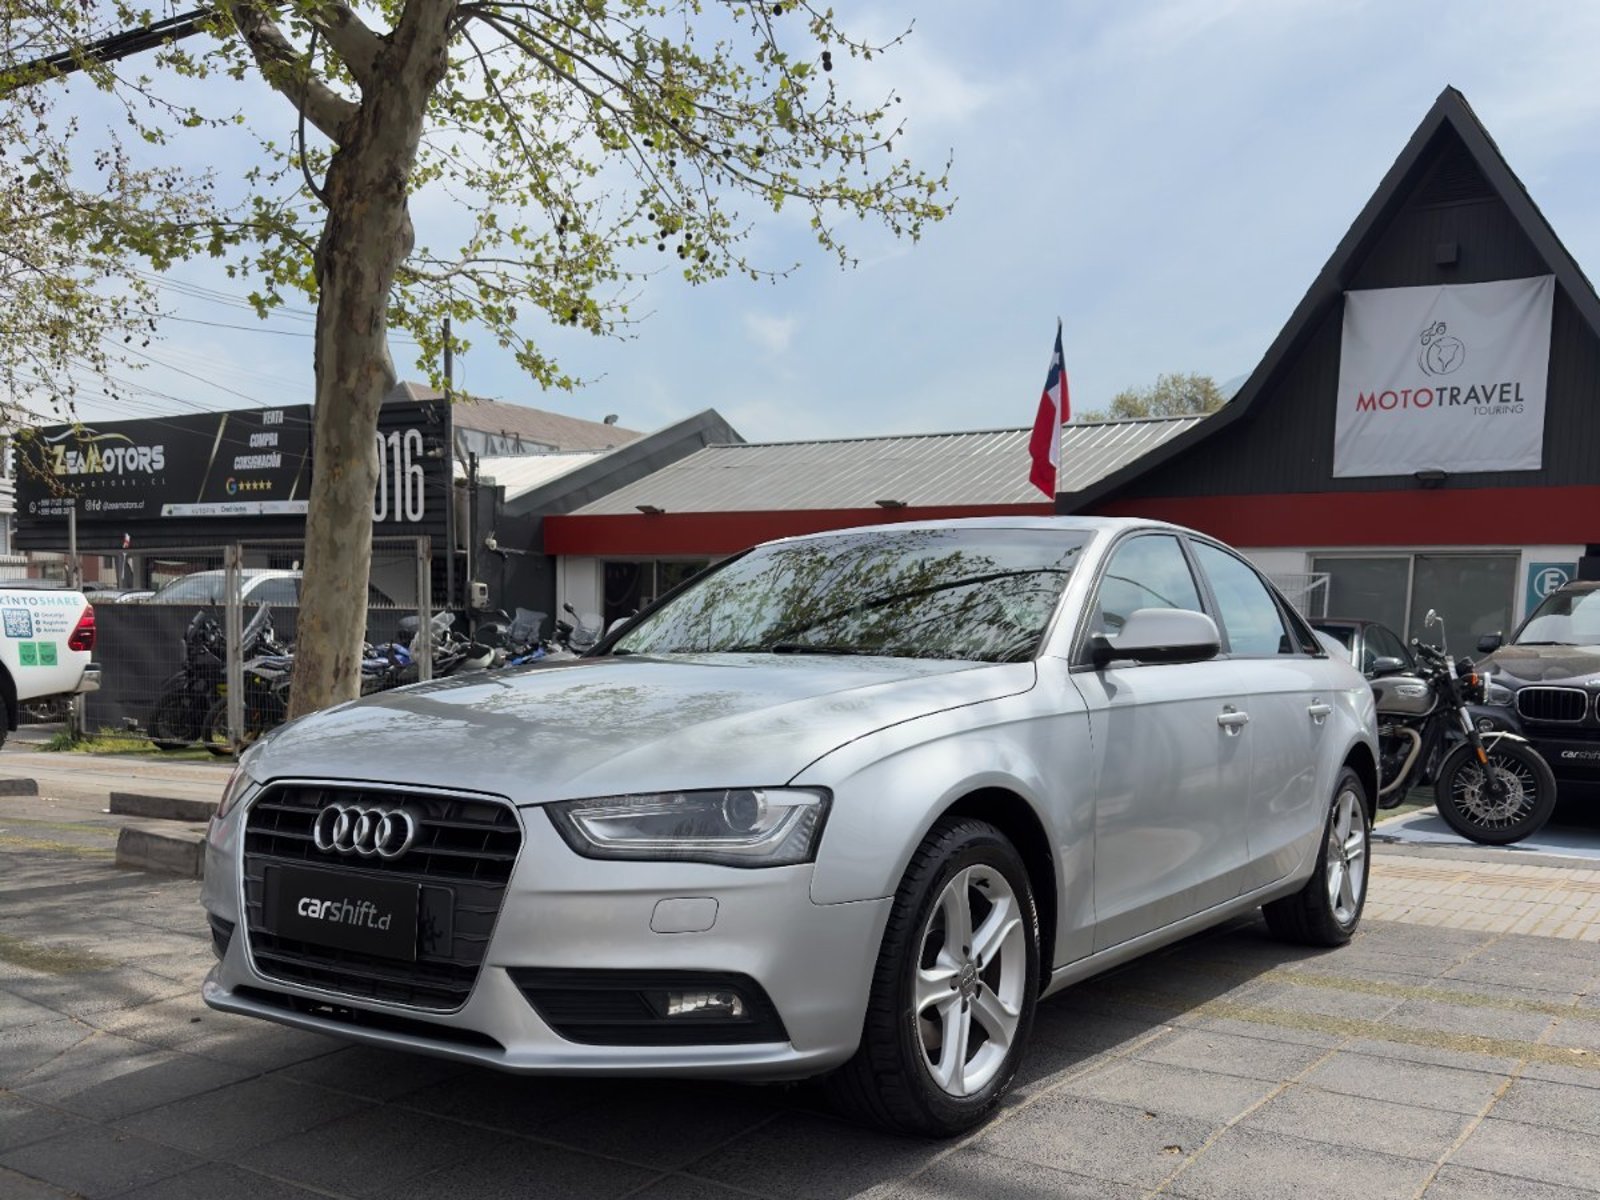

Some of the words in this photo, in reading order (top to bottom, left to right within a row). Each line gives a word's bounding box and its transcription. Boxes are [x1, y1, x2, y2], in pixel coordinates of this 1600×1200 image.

[1356, 382, 1524, 412] MOTOTRAVEL
[263, 410, 284, 425] VENTA
[1473, 403, 1524, 416] TOURING
[249, 432, 278, 448] COMPRA
[298, 897, 392, 930] carshift.cl
